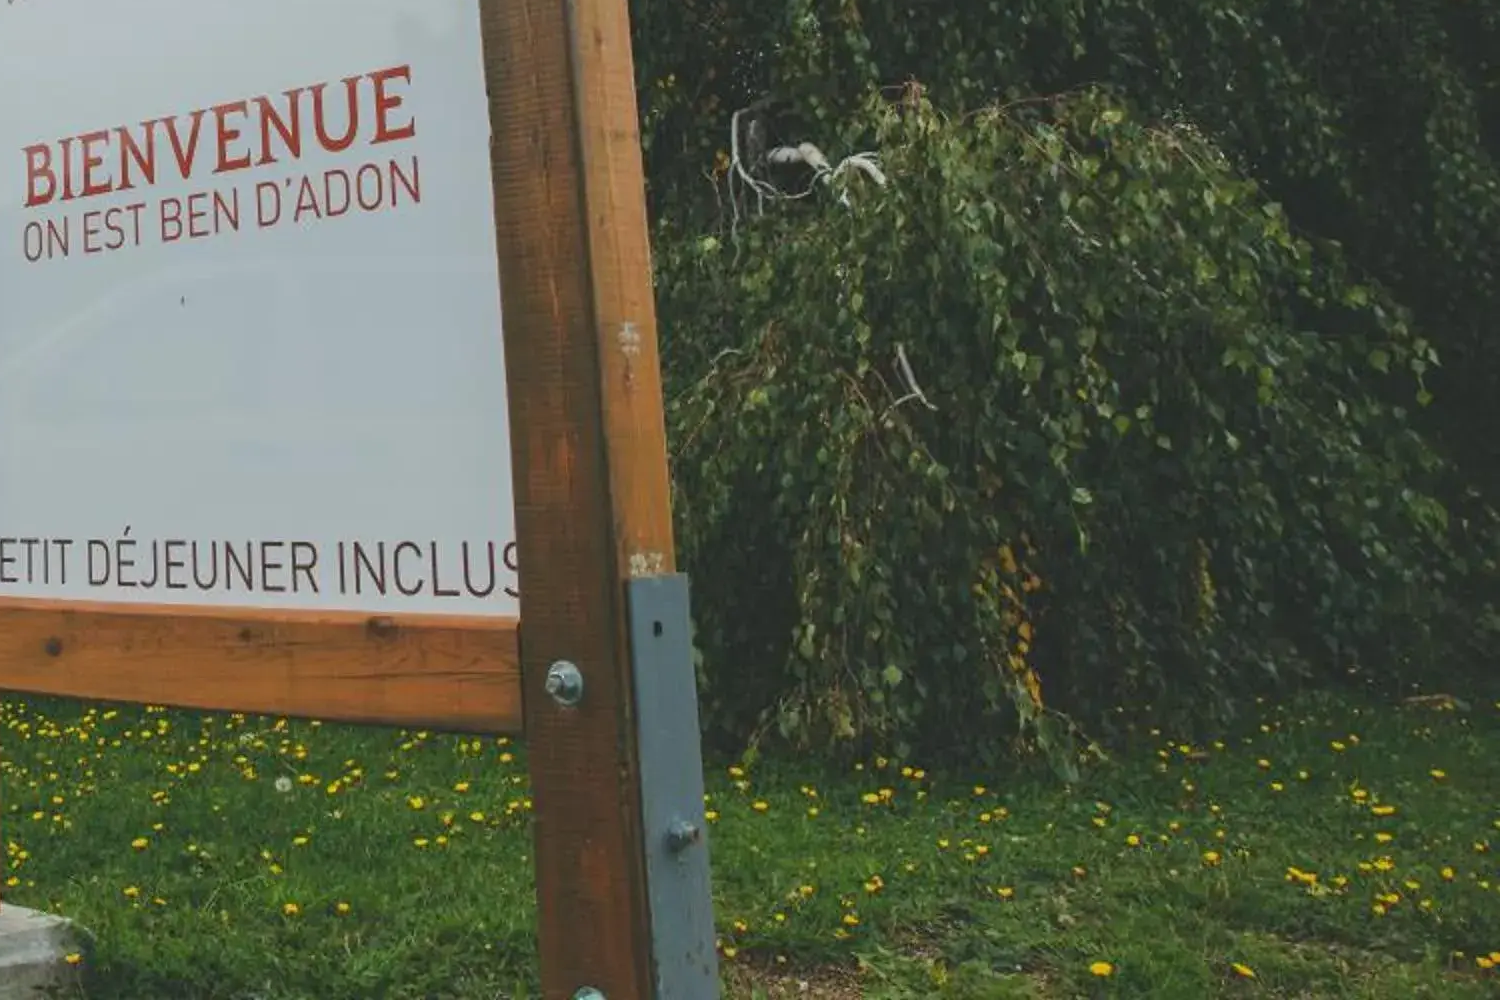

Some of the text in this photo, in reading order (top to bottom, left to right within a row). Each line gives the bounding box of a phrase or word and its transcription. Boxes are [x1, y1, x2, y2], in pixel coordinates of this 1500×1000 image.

[22, 65, 416, 208] BIENVENUE
[23, 155, 422, 262] ON EST BEN D'ADON
[87, 525, 319, 593] DÉJEUNER
